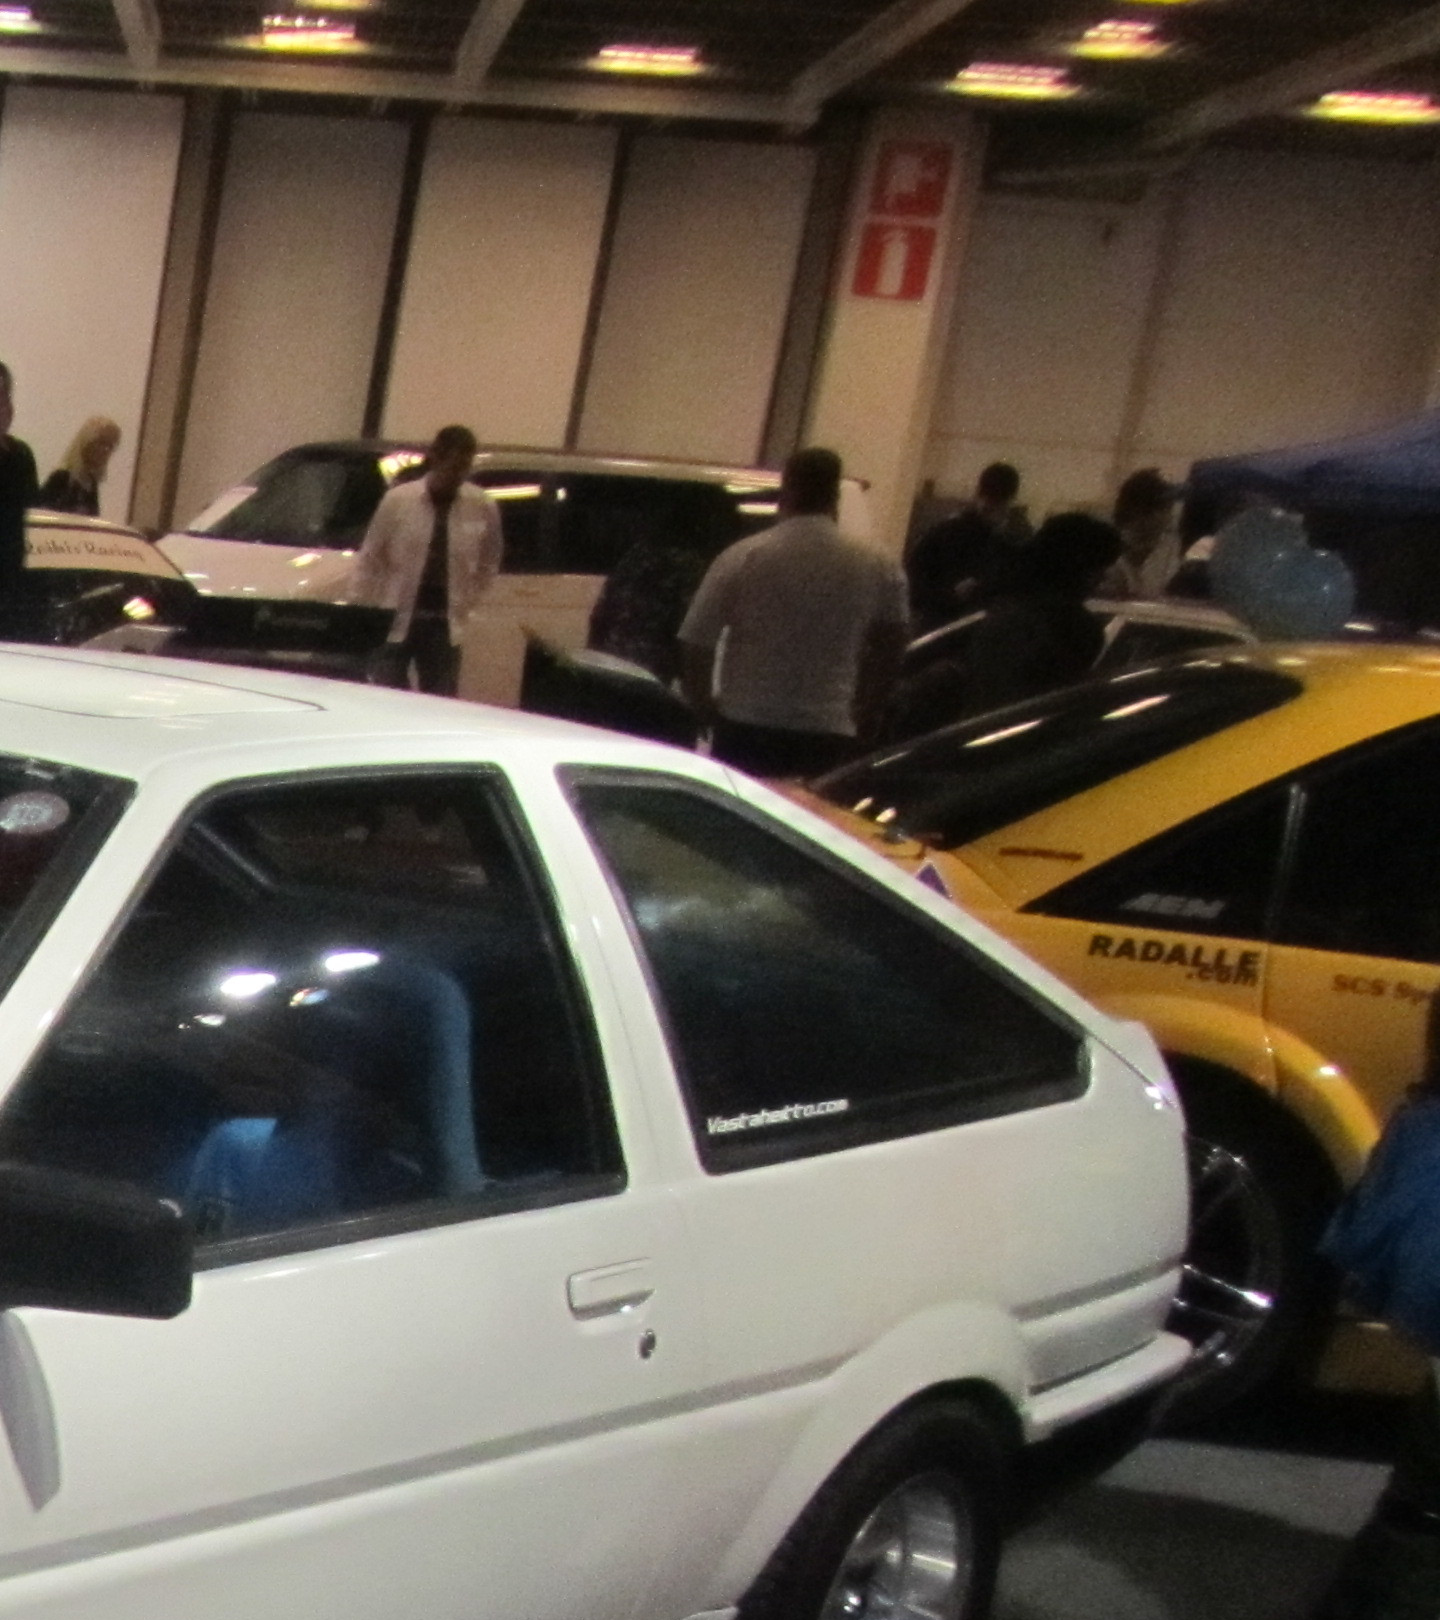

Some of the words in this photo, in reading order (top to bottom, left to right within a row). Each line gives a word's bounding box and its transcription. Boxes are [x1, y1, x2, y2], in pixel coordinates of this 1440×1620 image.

[1088, 934, 1260, 968] RADALLE
[1186, 963, 1258, 985] .com
[1333, 975, 1386, 996] SCS
